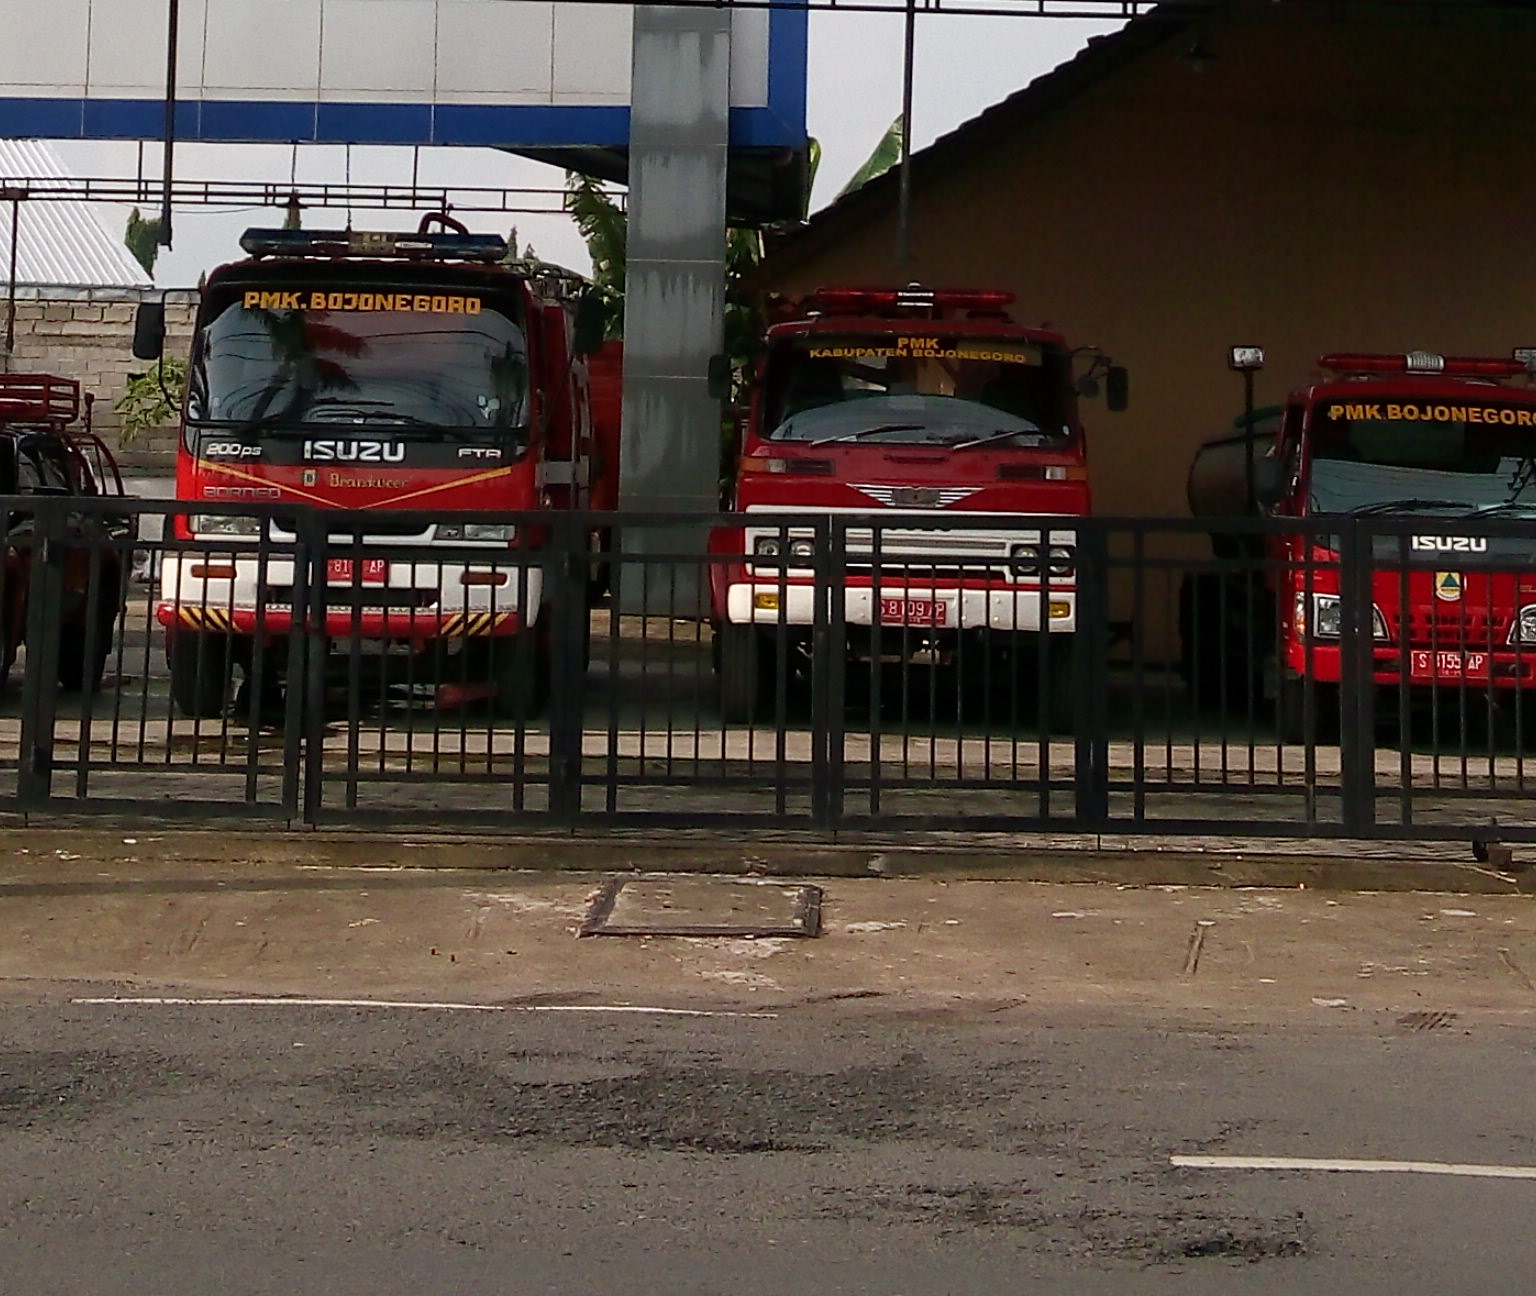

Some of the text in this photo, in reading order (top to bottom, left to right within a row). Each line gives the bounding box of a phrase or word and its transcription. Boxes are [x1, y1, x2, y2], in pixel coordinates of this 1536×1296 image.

[897, 337, 940, 350] PMK
[809, 348, 1027, 364] KABUPATEN BOJONEGORO
[206, 439, 502, 462] 200ps ISUZU FTR
[1412, 535, 1487, 552] ISUZU
[1467, 655, 1484, 671] AP
